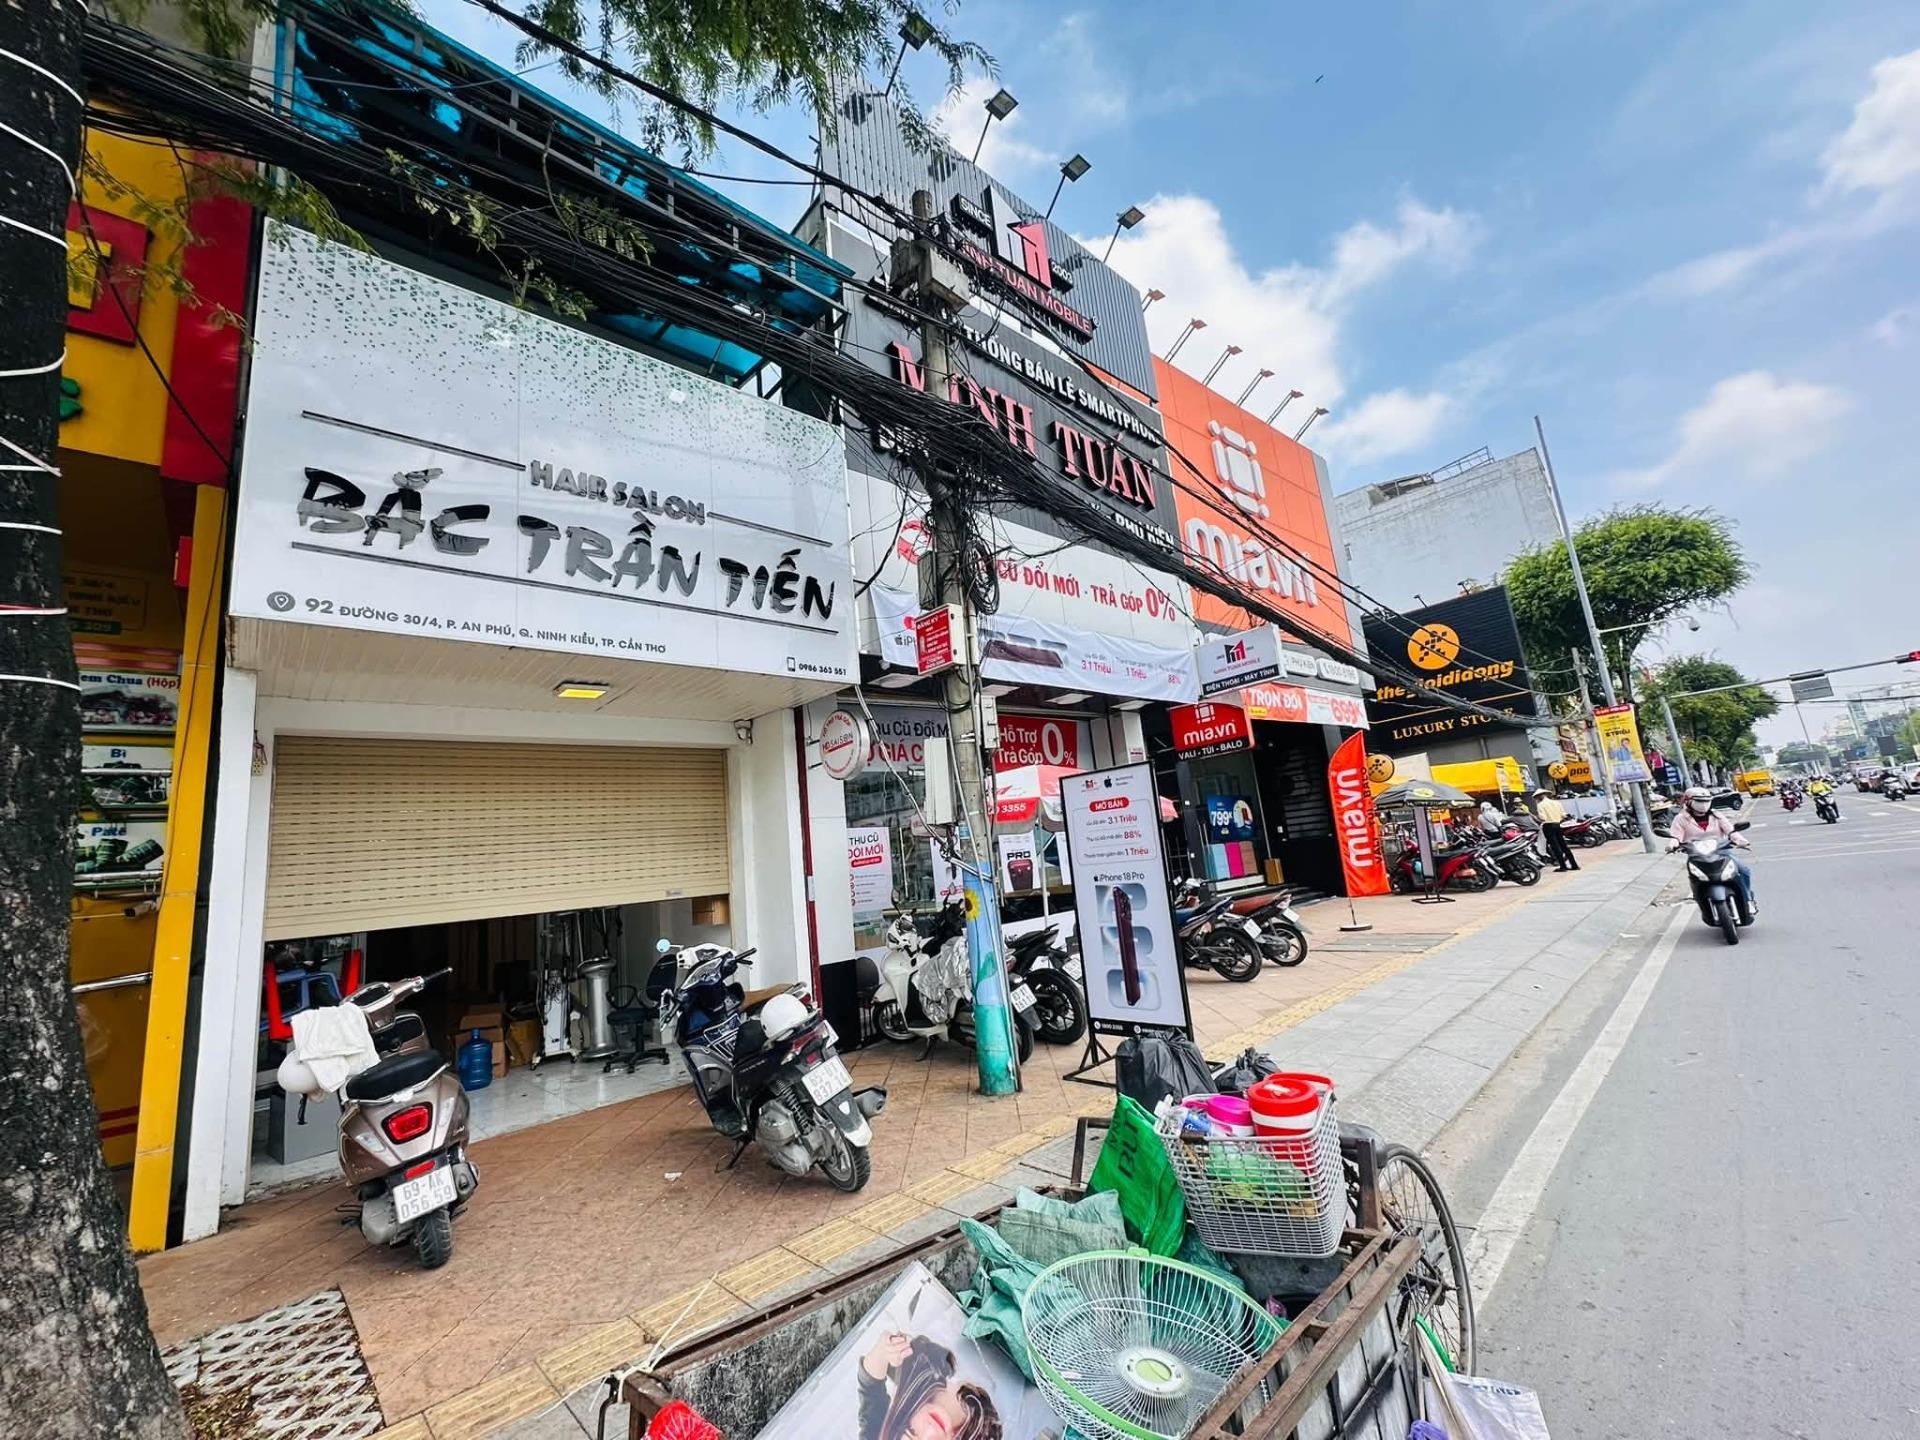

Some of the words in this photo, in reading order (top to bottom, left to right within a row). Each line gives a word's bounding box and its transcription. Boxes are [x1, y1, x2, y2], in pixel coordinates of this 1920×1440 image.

[960, 196, 991, 227] SINCE
[1041, 293, 1091, 334] MOBILE
[1025, 361, 1055, 390] BÁN
[1056, 375, 1077, 402] LẺ
[530, 459, 608, 503] HAIR
[612, 481, 706, 526] SALON
[517, 511, 702, 598] TRẦN
[718, 548, 836, 621] TIẾN
[1184, 517, 1320, 608] mia.vn
[1023, 560, 1050, 590] ĐỔI
[1053, 573, 1081, 598] MỚI
[1090, 583, 1118, 608] TRẢ
[1120, 590, 1144, 614] GÓP
[1145, 587, 1176, 622] 0%
[305, 597, 334, 614] 92
[339, 605, 400, 622] ĐƯỜNG
[403, 614, 442, 629] 30/4,
[446, 619, 457, 630] P.
[461, 622, 481, 632] AN
[485, 624, 515, 638] PHÚ,
[519, 628, 533, 638] Q.
[537, 630, 567, 642] NINH
[570, 632, 598, 647] KIỀU,
[601, 638, 615, 648] TP.
[618, 638, 643, 651] CẦN
[645, 643, 667, 654] THƠ
[81, 675, 102, 683] em
[106, 674, 143, 685] Chua
[797, 663, 819, 674] 0986
[875, 720, 891, 736] hu
[893, 720, 911, 736] Cũ
[914, 719, 936, 737] Đổi
[999, 724, 1016, 743] Hỗ
[1016, 728, 1038, 748] Trợ
[1184, 720, 1238, 745] mia.vn
[1392, 719, 1456, 740] LUXURY
[998, 745, 1017, 764] Trả
[1018, 747, 1043, 765] Góp
[1178, 751, 1197, 760] VALI
[1201, 744, 1215, 755] TÚI
[1220, 740, 1243, 751] BALO
[1360, 766, 1371, 798] BALO
[1119, 813, 1138, 824] Triệu
[1336, 767, 1374, 868] mia.vn
[1006, 850, 1031, 860] PRO
[1099, 873, 1123, 883] iPhone
[1133, 871, 1145, 880] Pro
